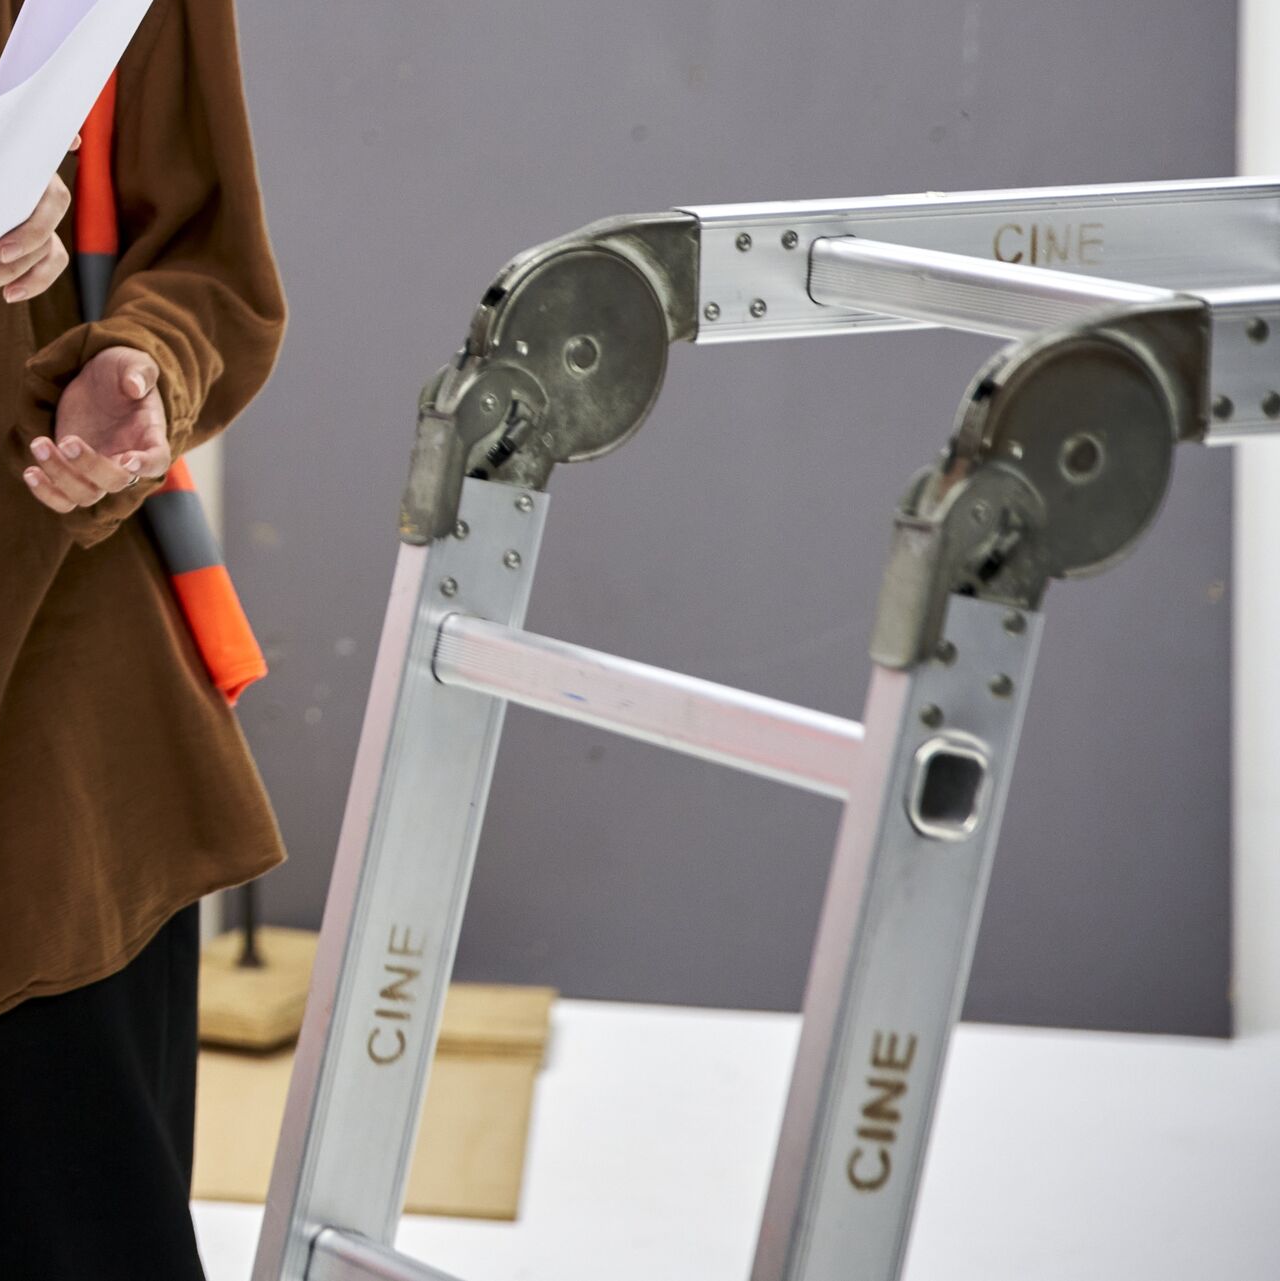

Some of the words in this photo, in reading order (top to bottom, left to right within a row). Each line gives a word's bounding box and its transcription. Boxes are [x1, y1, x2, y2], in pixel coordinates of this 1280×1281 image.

[993, 223, 1105, 265] CINE
[367, 923, 428, 1066] CINE
[846, 1030, 918, 1194] CINE
